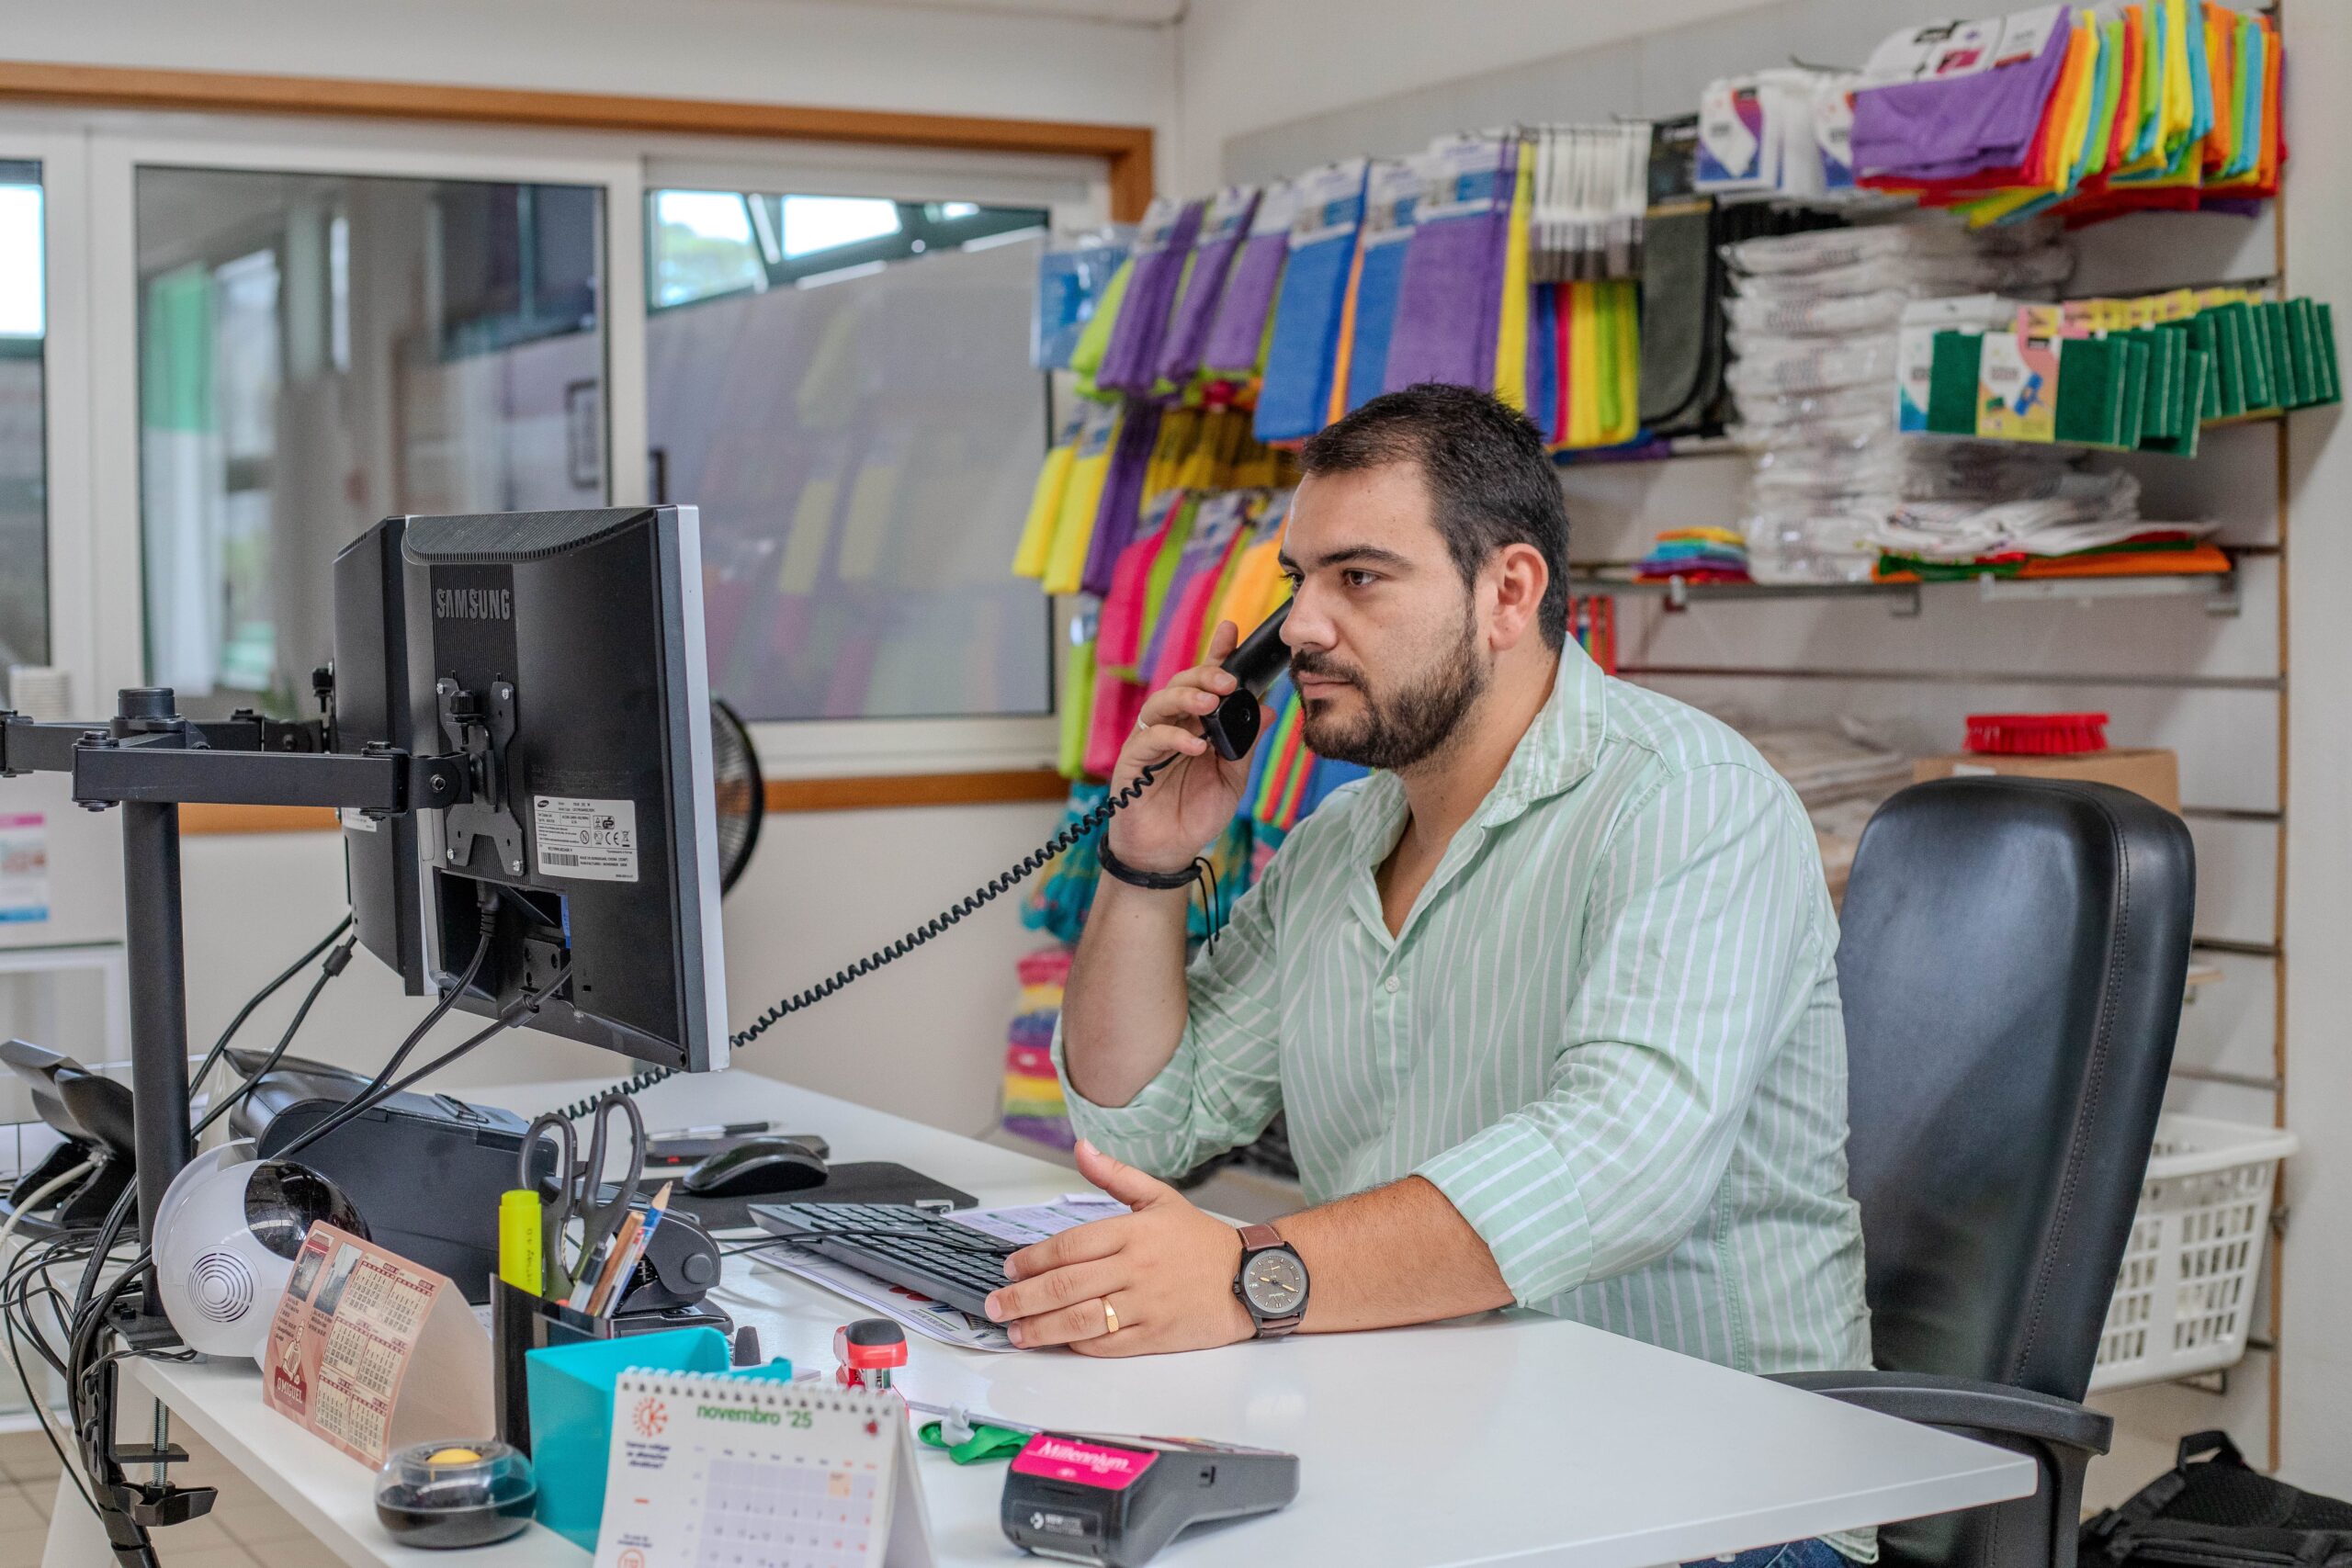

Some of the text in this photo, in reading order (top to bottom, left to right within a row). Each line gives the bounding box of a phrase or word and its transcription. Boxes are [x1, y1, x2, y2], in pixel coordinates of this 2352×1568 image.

[436, 589, 511, 620] SAMSUNG
[696, 1404, 813, 1428] novembro '25
[1037, 1441, 1129, 1470] Millennium
